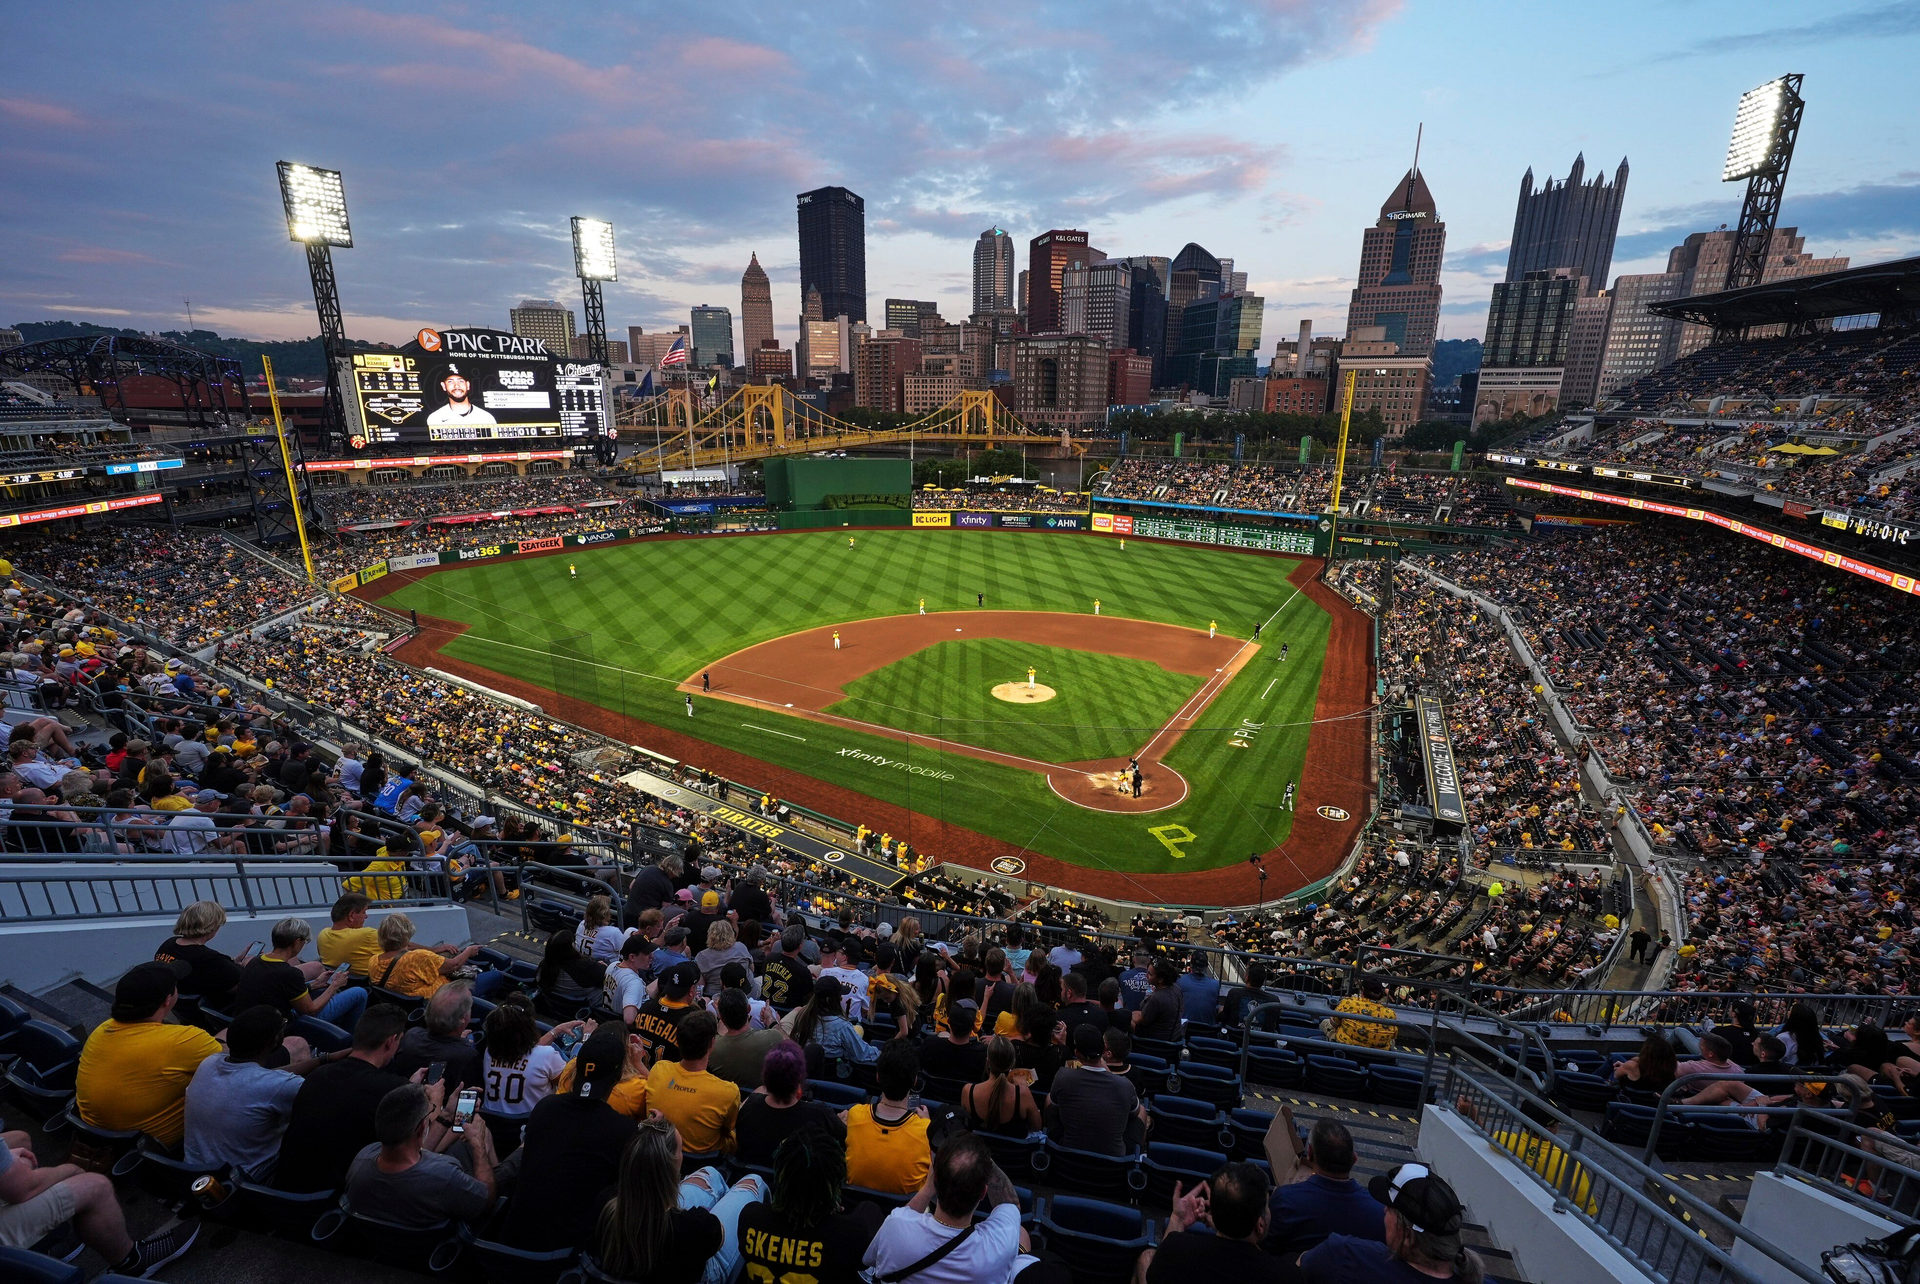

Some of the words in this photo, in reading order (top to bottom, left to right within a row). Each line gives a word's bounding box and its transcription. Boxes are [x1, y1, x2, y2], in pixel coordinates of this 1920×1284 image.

[1390, 212, 1427, 220] HIGHMARK
[444, 332, 492, 352] PNC
[496, 336, 548, 354] PARK
[406, 358, 416, 371] P
[565, 363, 600, 377] Chicago
[500, 378, 535, 386] QUERO
[989, 474, 1014, 486] Miller
[961, 516, 987, 526] xfinity
[1058, 519, 1076, 527] AHN
[586, 532, 615, 541] VANDA
[638, 526, 663, 535] BETMGM
[1881, 525, 1889, 539] 0
[521, 538, 560, 551] SEATGEEK
[459, 545, 500, 559] bet365
[416, 556, 436, 565] paze
[1429, 722, 1444, 736] PNC
[1431, 742, 1449, 753] TO
[836, 747, 894, 766] xfinity
[893, 762, 955, 782] mobile
[1433, 753, 1456, 794] WELCOME
[711, 807, 784, 838] PIRATES
[1148, 823, 1198, 859] P
[762, 974, 789, 1003] 22
[585, 1063, 596, 1077] P
[486, 1070, 526, 1104] 30
[745, 1227, 824, 1267] SKENES
